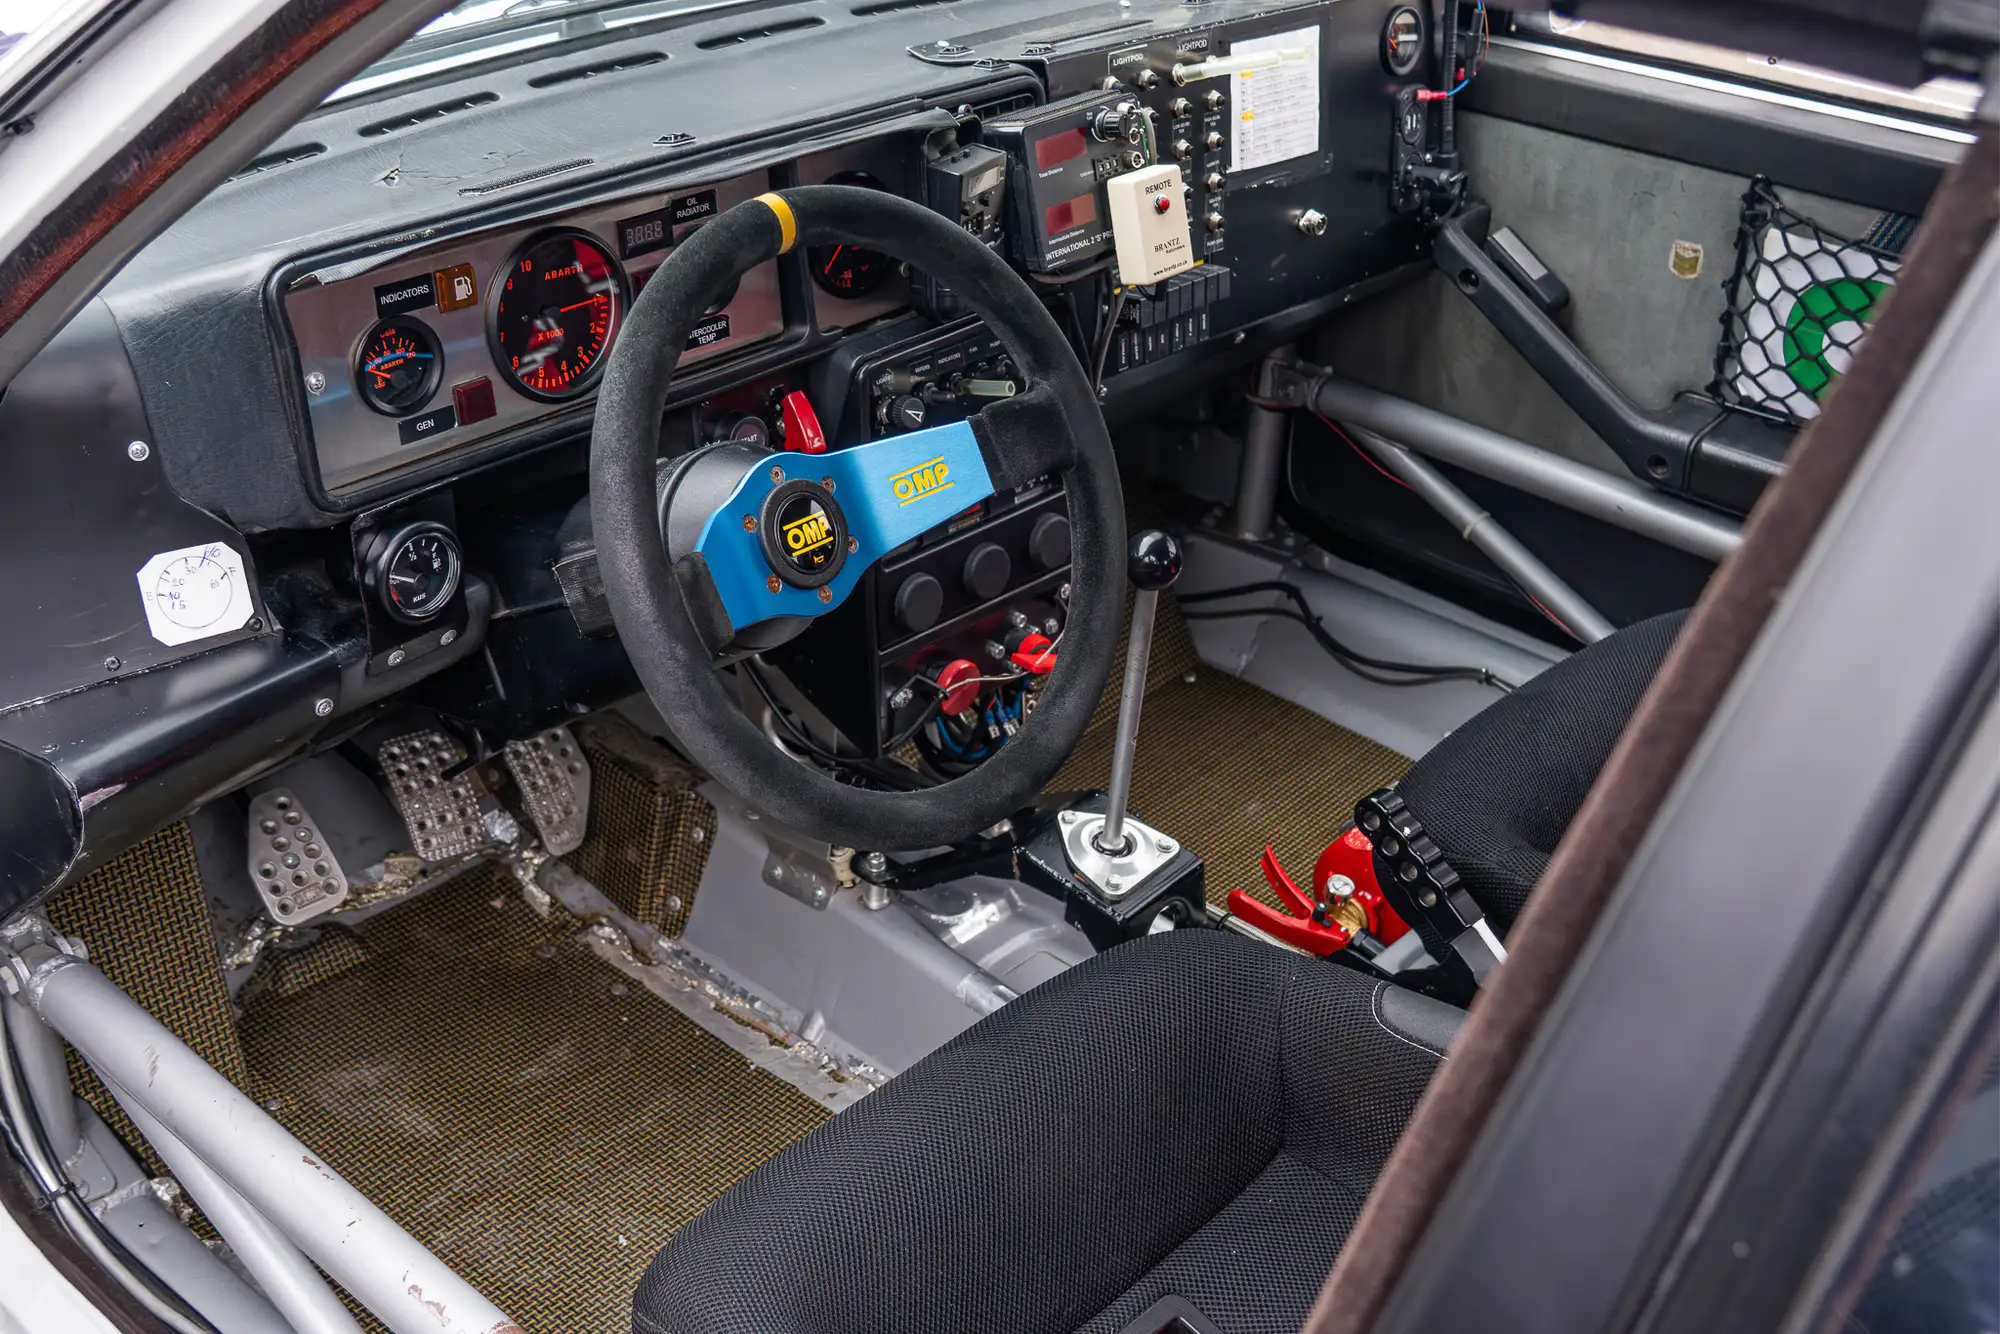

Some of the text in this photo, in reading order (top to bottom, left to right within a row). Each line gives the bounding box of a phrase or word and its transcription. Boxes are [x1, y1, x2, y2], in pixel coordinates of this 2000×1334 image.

[1178, 39, 1208, 52] LIGHTPOD
[1113, 53, 1144, 66] LIGHTPOD
[1145, 179, 1172, 195] REMOTE
[686, 197, 698, 206] OIL
[676, 203, 710, 219] RADIATOR
[1045, 239, 1091, 261] INTERNATIONAL
[1091, 236, 1095, 244] 2
[1154, 237, 1181, 253] BRANTZ
[520, 259, 532, 273] 10
[544, 264, 584, 281] ABARTH
[380, 284, 430, 305] INDICATORS
[538, 328, 564, 341] X 1000
[589, 322, 596, 334] 2
[689, 320, 727, 339] TERCOOLER
[698, 333, 717, 345] TEMP
[578, 346, 584, 358] 3
[938, 353, 961, 364] INDICATORS
[381, 359, 404, 371] ABARTH
[512, 356, 519, 368] 6
[561, 360, 567, 372] 4
[538, 366, 545, 377] 5
[416, 418, 435, 432] GEN
[893, 462, 949, 500] OMP
[787, 516, 829, 550] OMP
[413, 593, 426, 603] KUS
